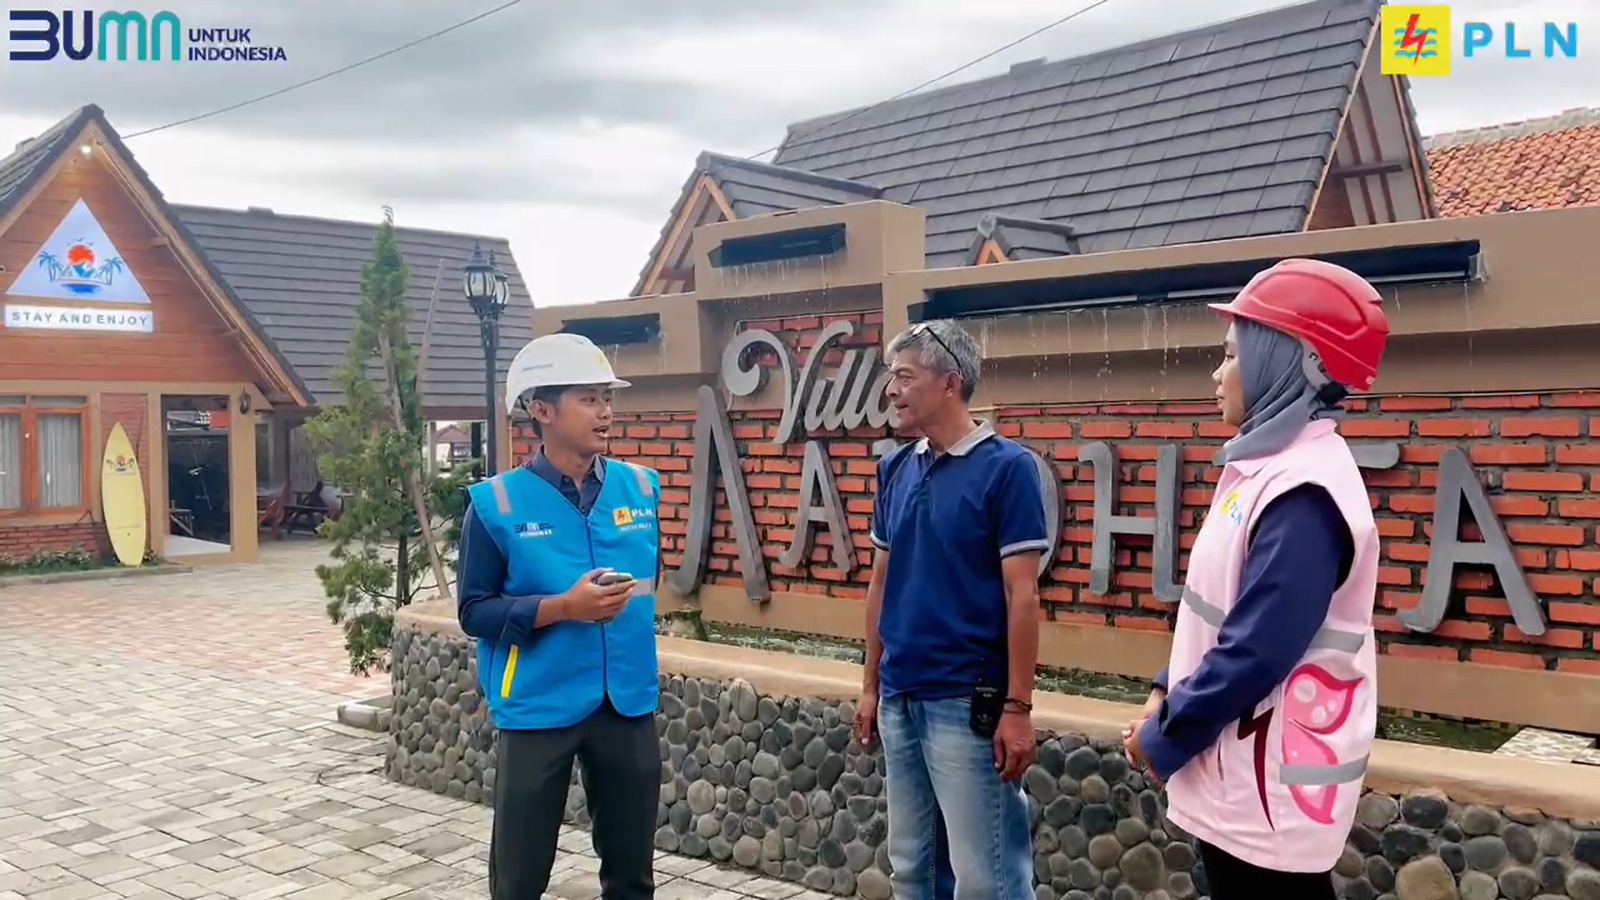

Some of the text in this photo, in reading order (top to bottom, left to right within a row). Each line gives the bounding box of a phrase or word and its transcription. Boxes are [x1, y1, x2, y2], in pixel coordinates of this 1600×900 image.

[12, 311, 148, 326] STAY AND ENJOY
[630, 507, 654, 518] PLN
